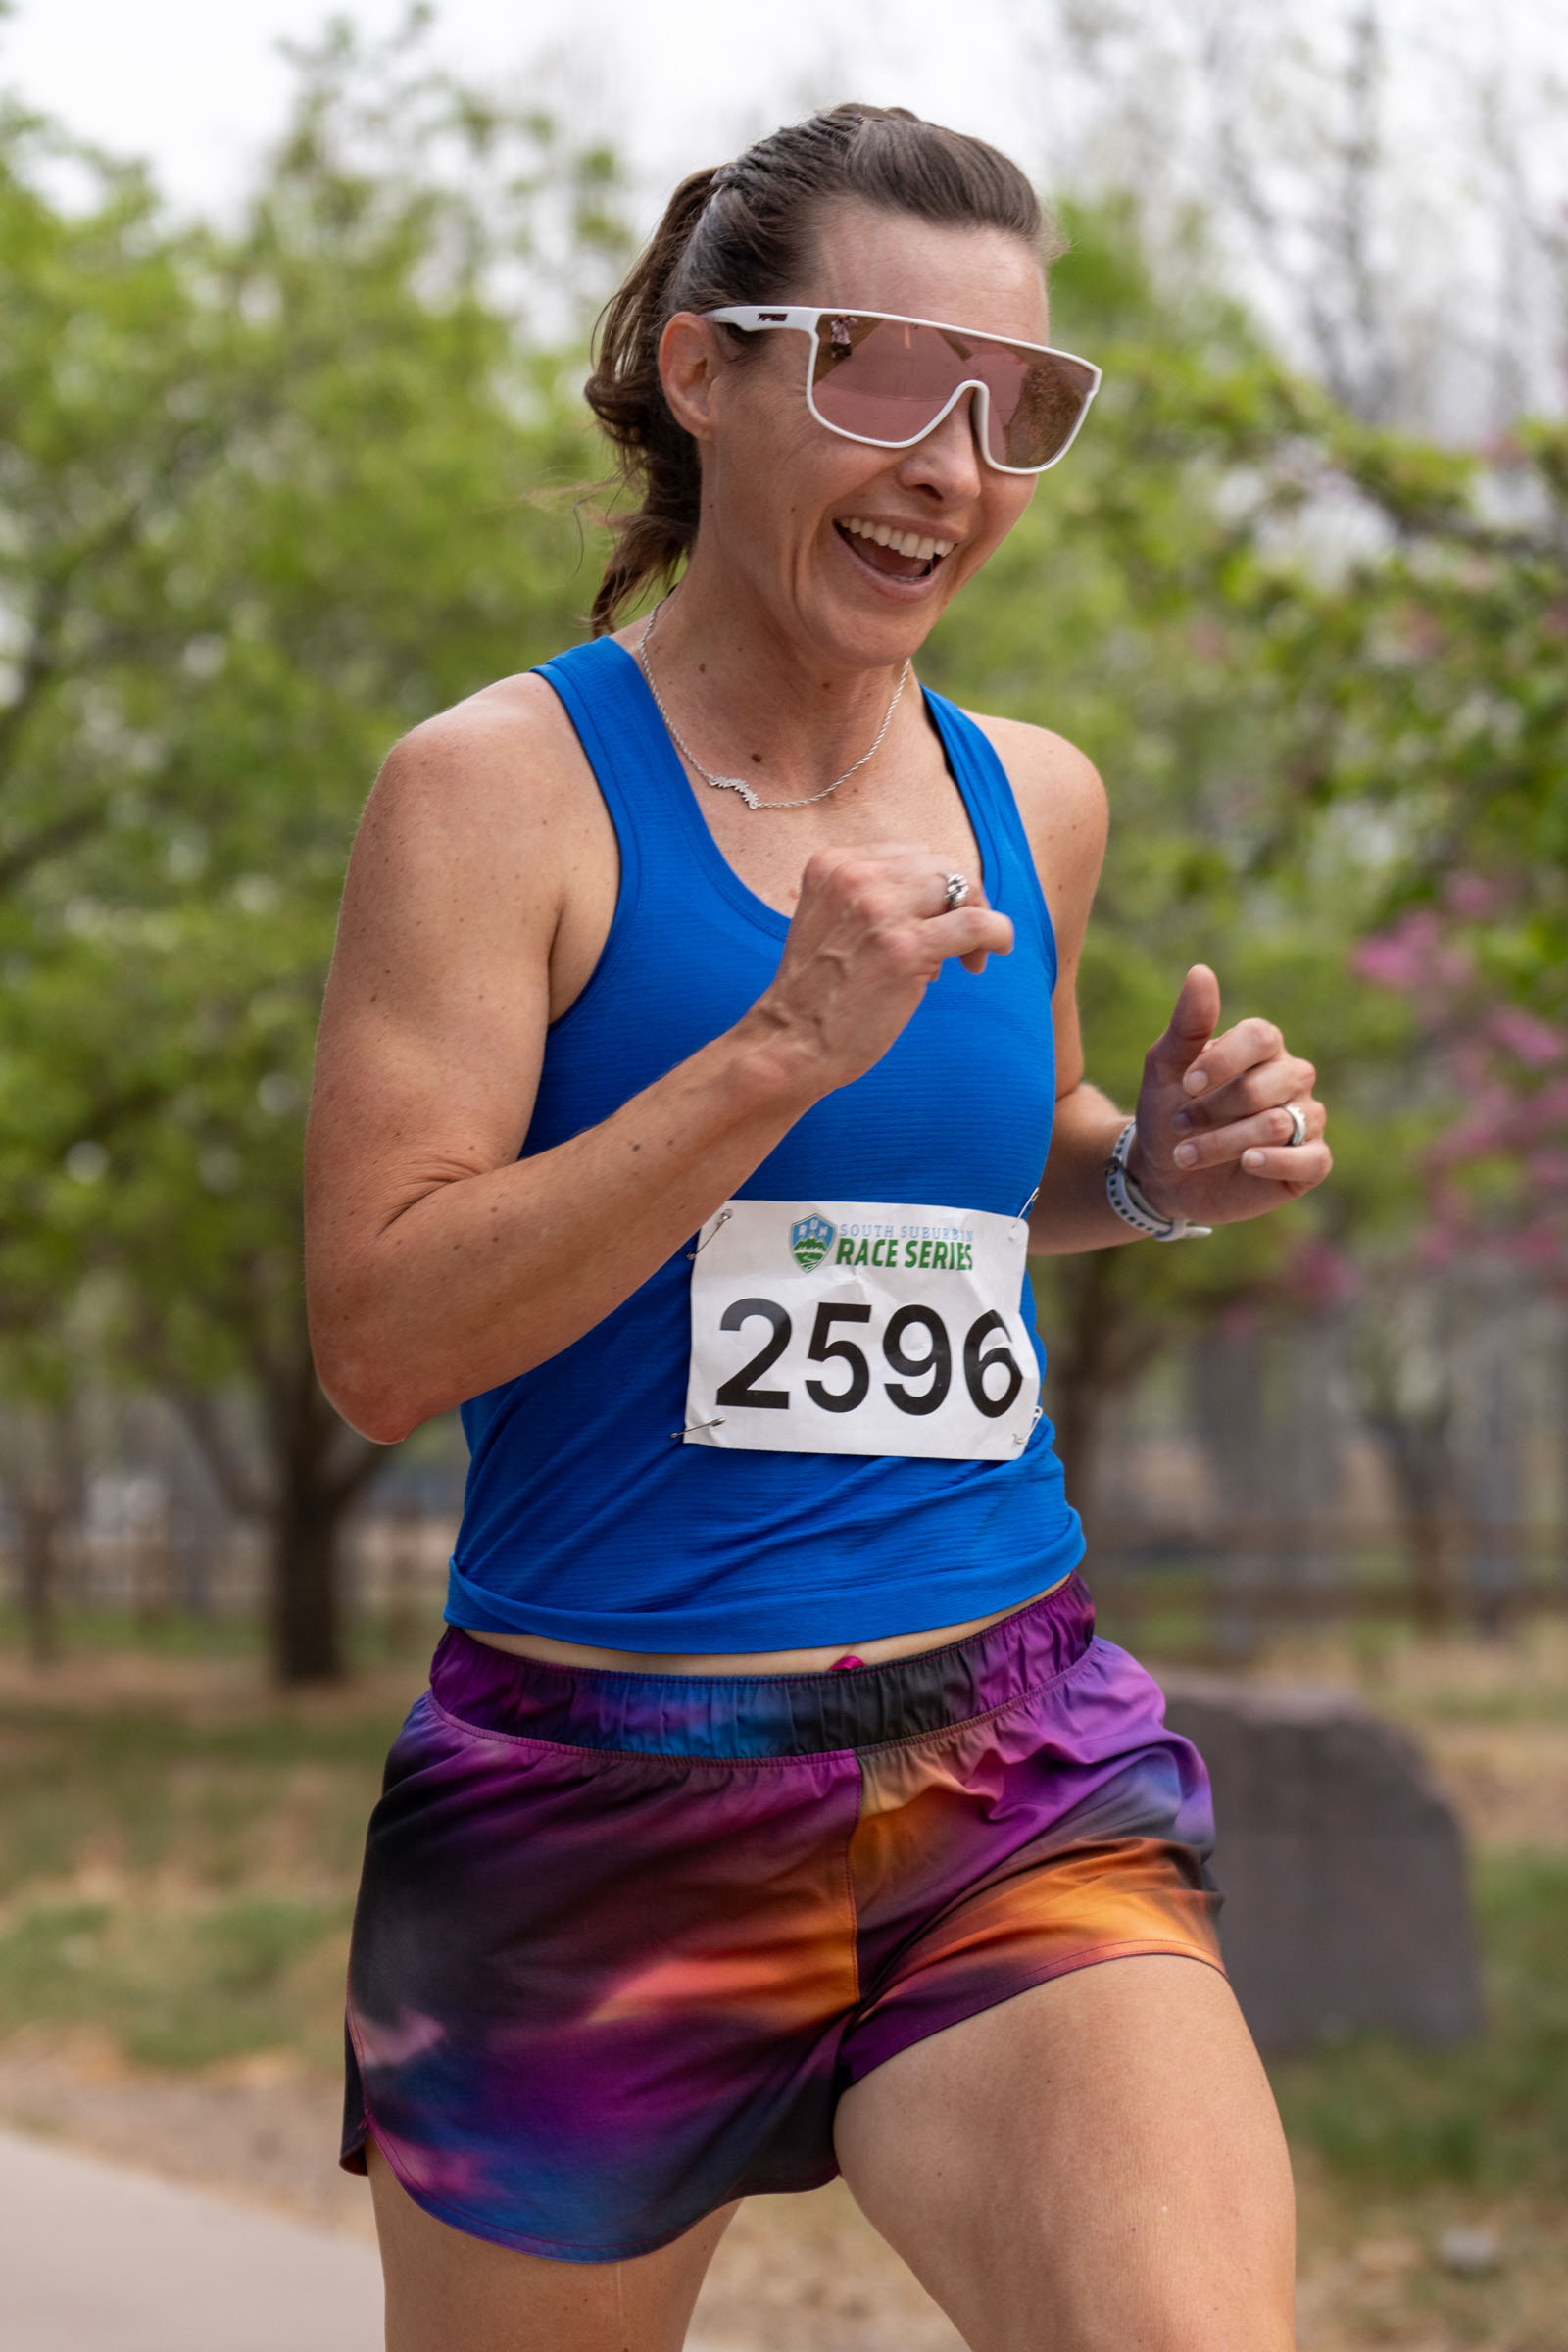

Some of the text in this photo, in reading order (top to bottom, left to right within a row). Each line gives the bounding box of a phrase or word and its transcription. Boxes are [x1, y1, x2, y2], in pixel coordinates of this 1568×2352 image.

[799, 1218, 829, 1237] RUN
[839, 1223, 895, 1238] SOUTH
[835, 1238, 973, 1270] RACE SERIES
[716, 1298, 1023, 1418] 2596
